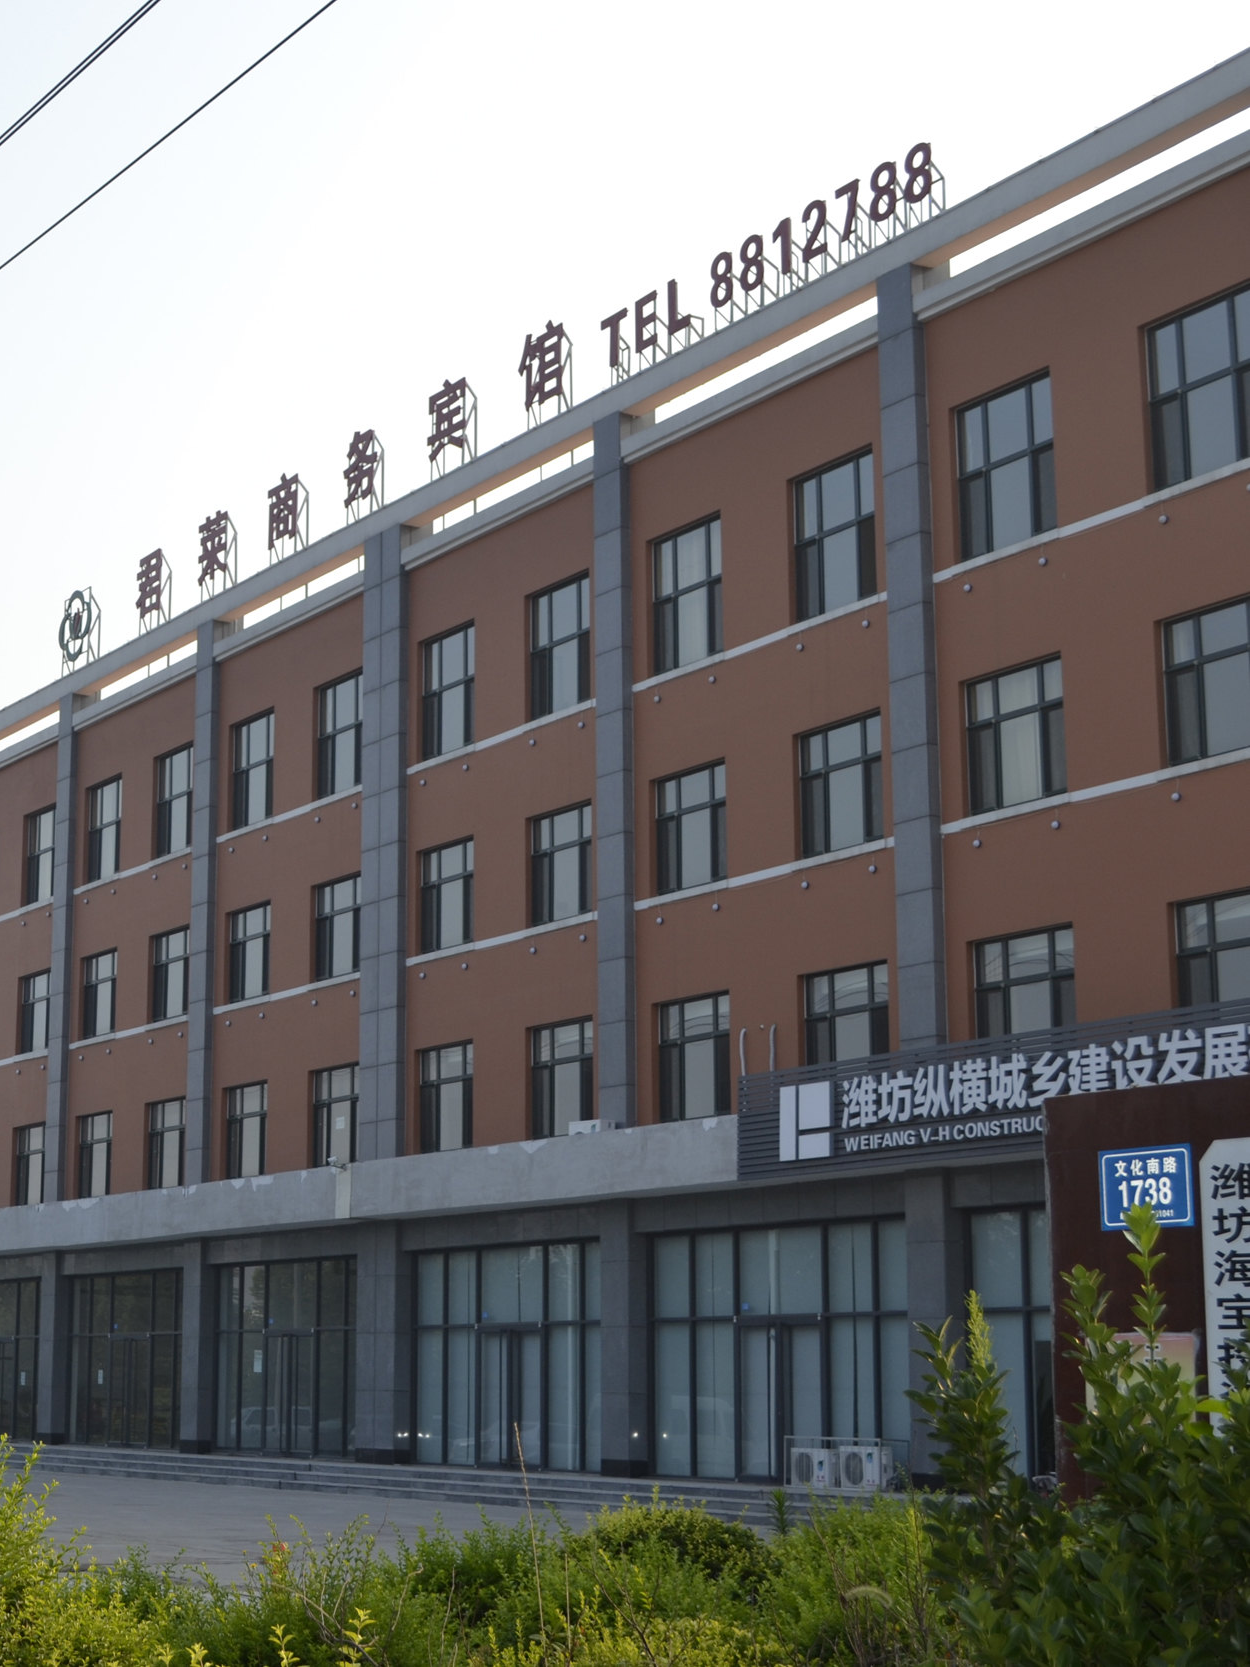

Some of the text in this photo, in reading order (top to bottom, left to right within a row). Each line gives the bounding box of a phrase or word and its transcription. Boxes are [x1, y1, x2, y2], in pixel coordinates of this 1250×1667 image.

[135, 142, 934, 622] 君莱商务宾馆 TEL 8812788
[840, 1023, 1250, 1129] 潍坊纵横城乡建设发展
[844, 1130, 916, 1152] WEIFANG
[1114, 1156, 1177, 1178] 文化南路
[1118, 1176, 1173, 1208] 1738
